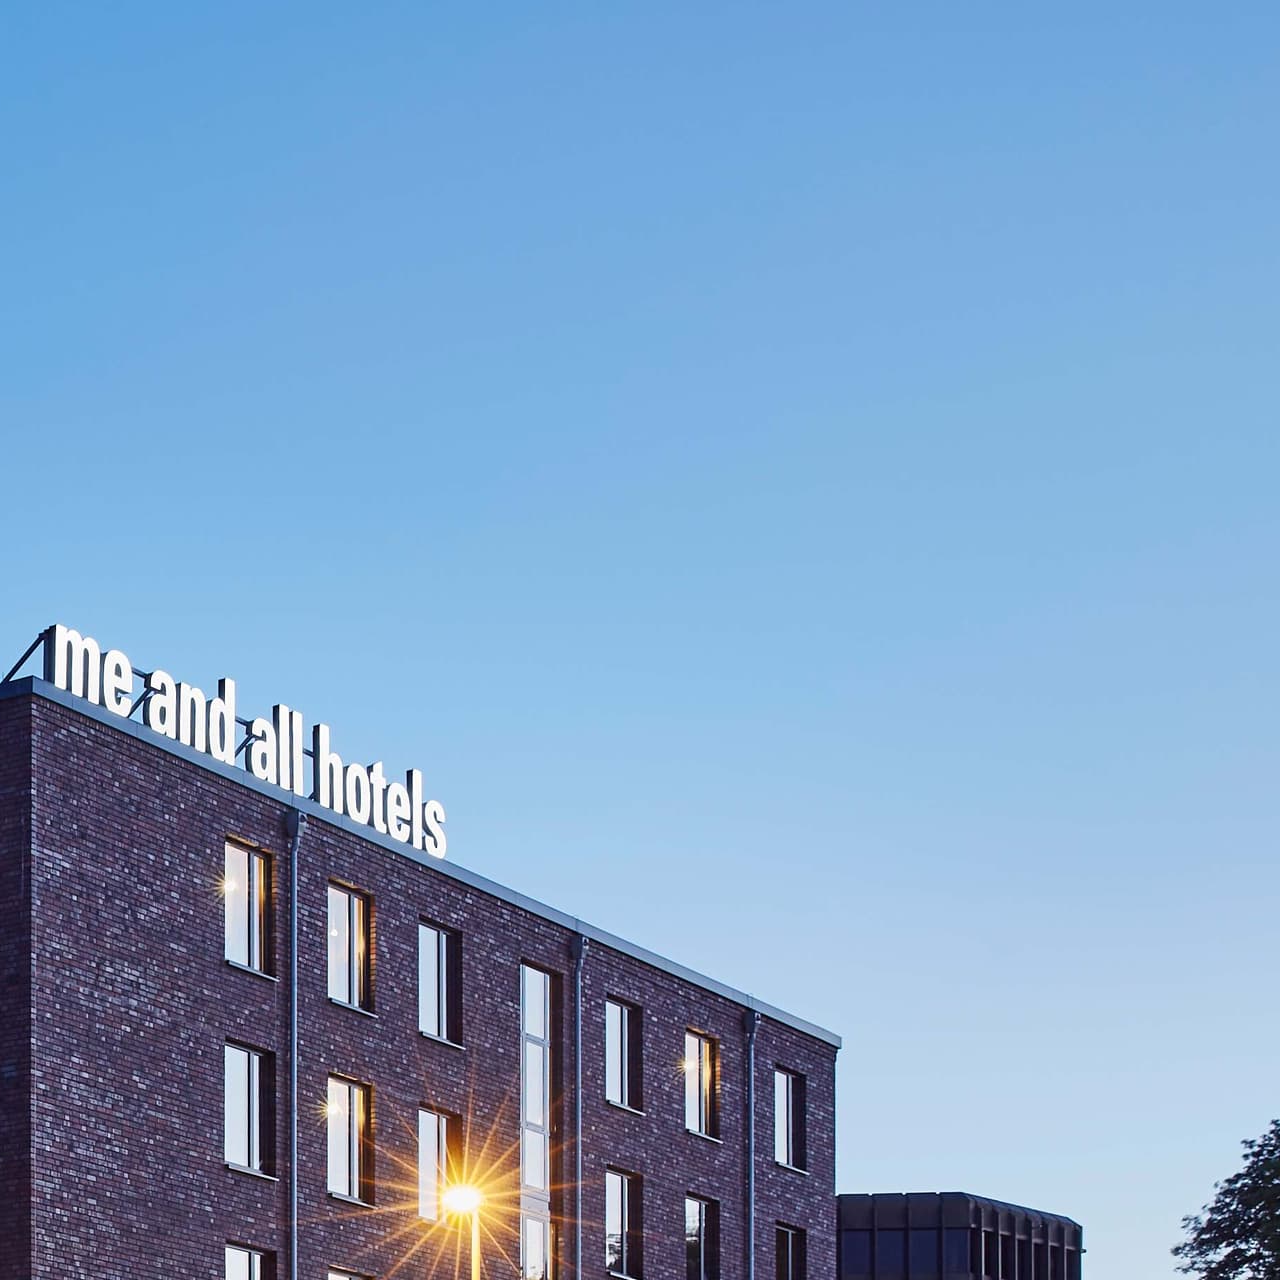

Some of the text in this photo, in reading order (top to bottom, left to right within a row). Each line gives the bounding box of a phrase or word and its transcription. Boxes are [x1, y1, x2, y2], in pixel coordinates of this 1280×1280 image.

[47, 623, 447, 859] me and all hotels
